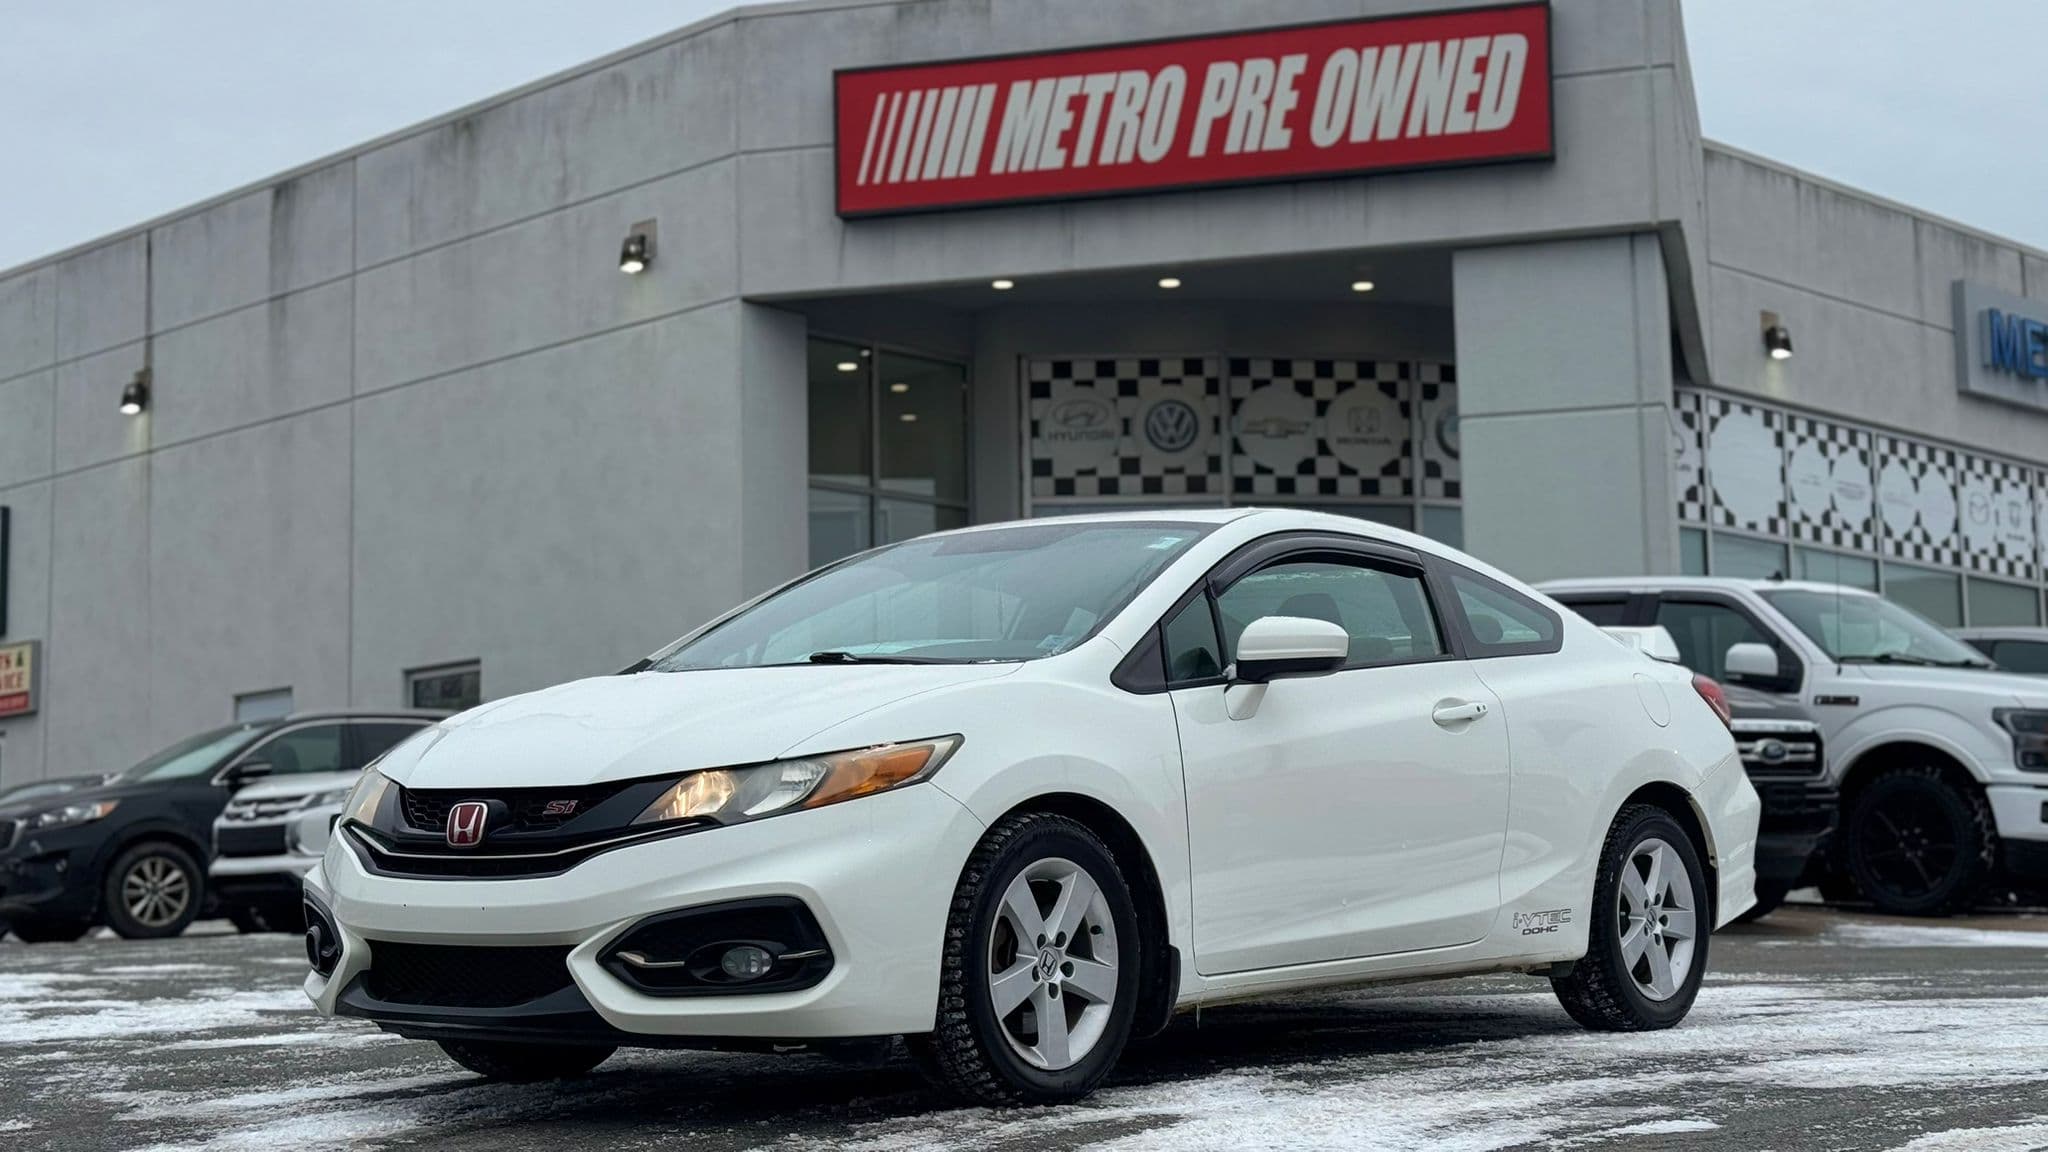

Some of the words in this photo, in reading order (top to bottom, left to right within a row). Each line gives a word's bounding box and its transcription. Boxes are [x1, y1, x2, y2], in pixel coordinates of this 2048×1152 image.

[990, 65, 1187, 175] METRO
[1188, 54, 1308, 158] PRE
[1309, 33, 1529, 148] OWNED
[542, 799, 580, 815] Si
[1521, 925, 1558, 936] DOHC
